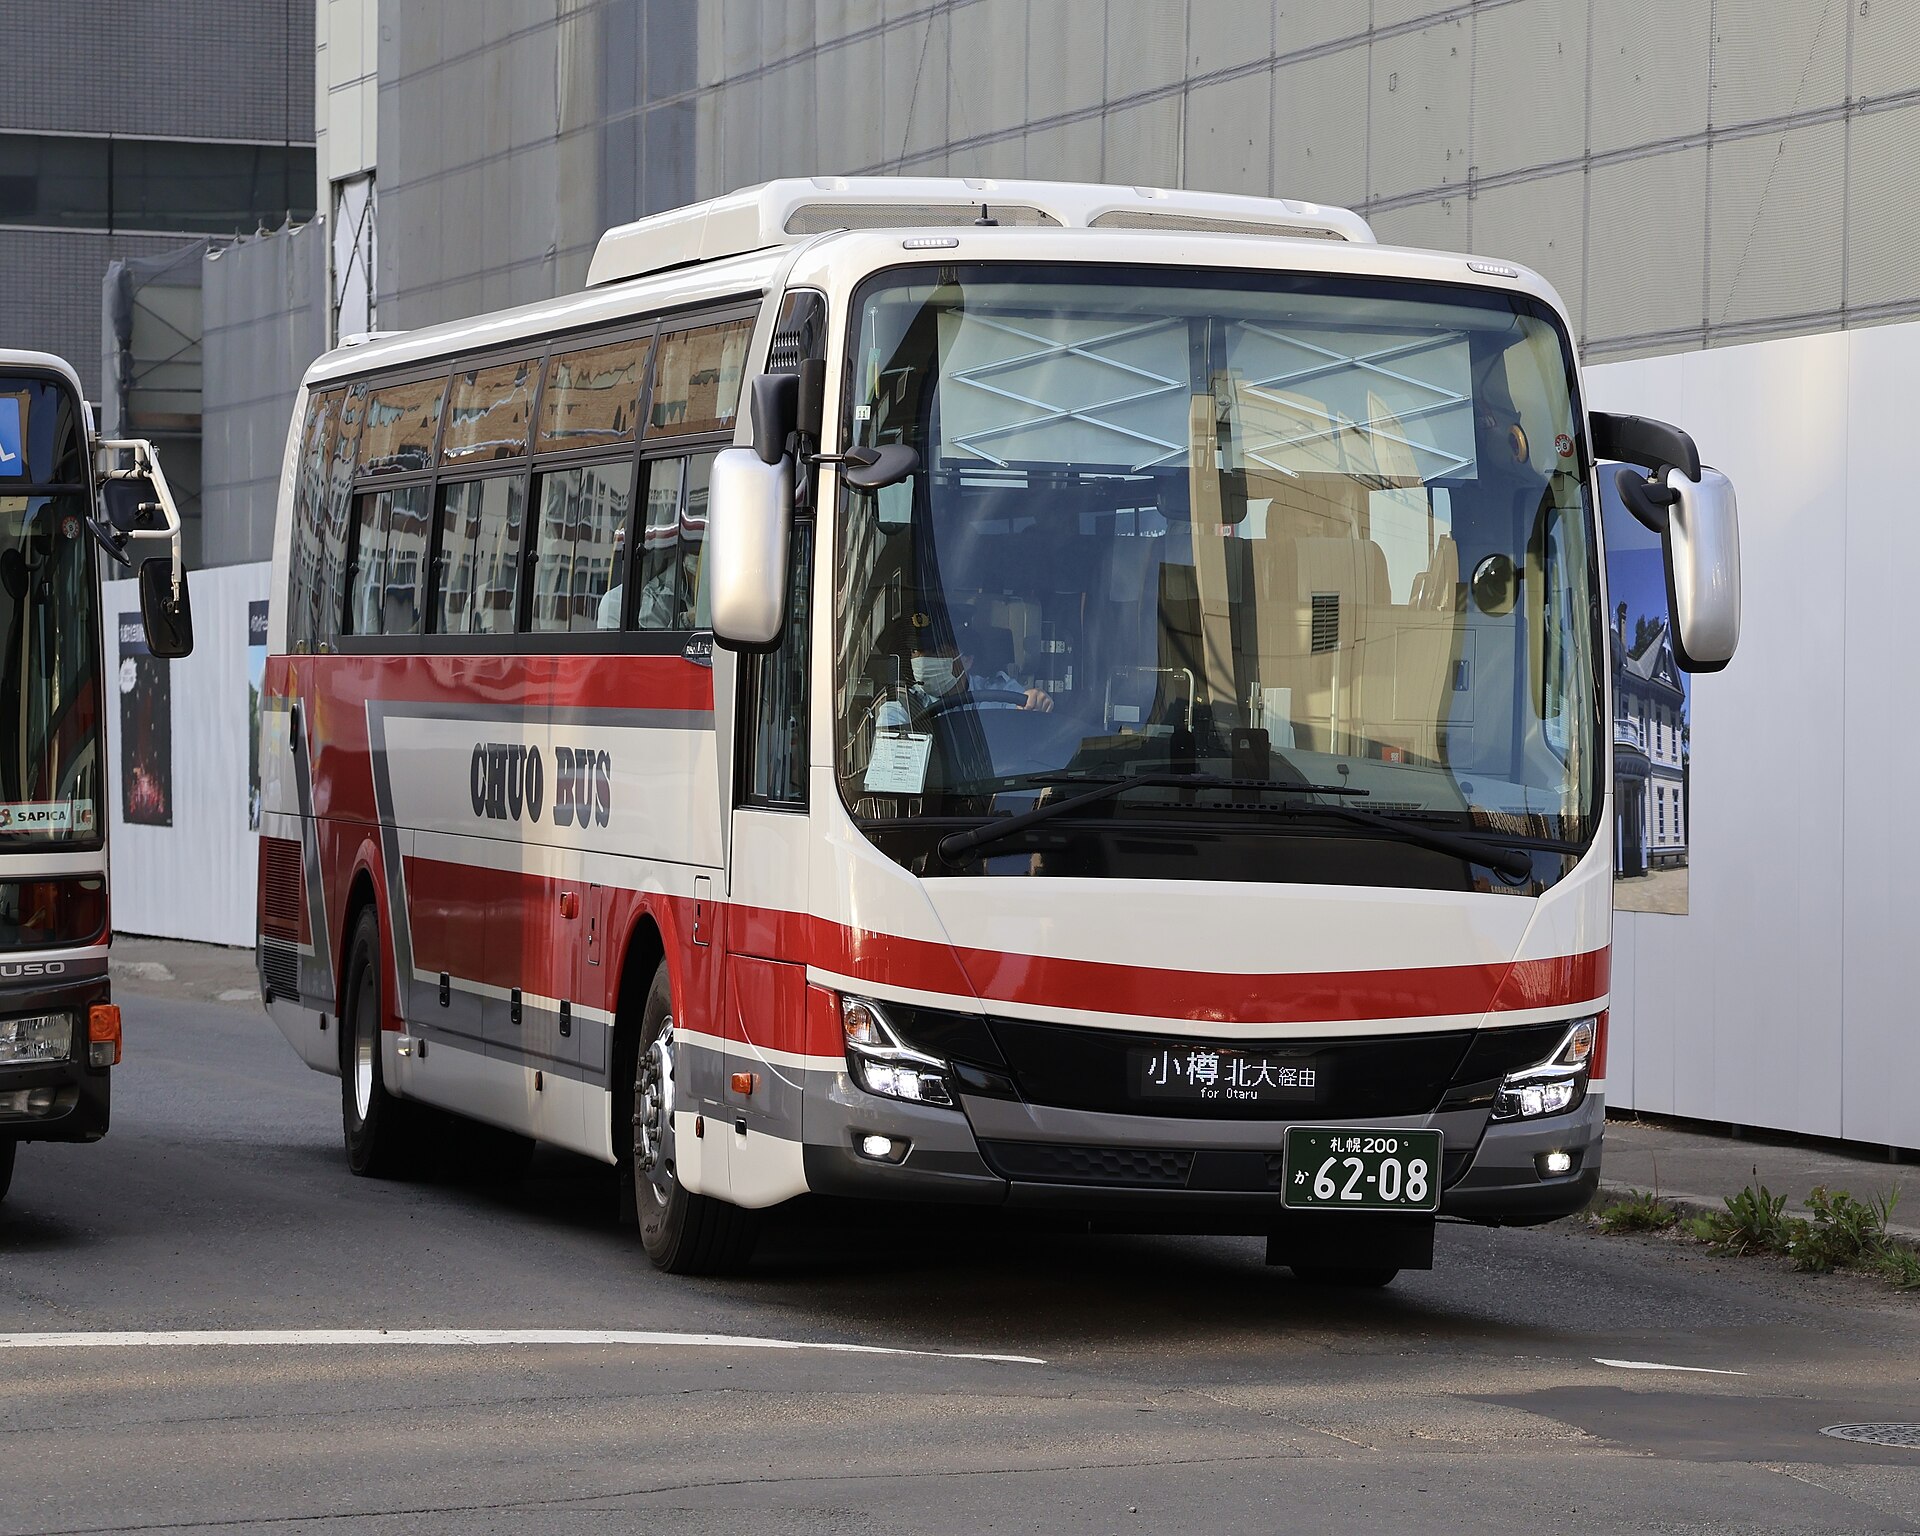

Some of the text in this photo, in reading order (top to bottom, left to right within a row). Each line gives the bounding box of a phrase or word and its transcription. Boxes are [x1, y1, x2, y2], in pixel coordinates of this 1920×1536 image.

[470, 742, 611, 829] CHUO BUS
[18, 811, 66, 822] SAPICA
[1148, 1051, 1316, 1088] 小樽 北大経由
[1201, 1087, 1258, 1100] for Otaru
[1294, 1156, 1428, 1202] か 62-08
